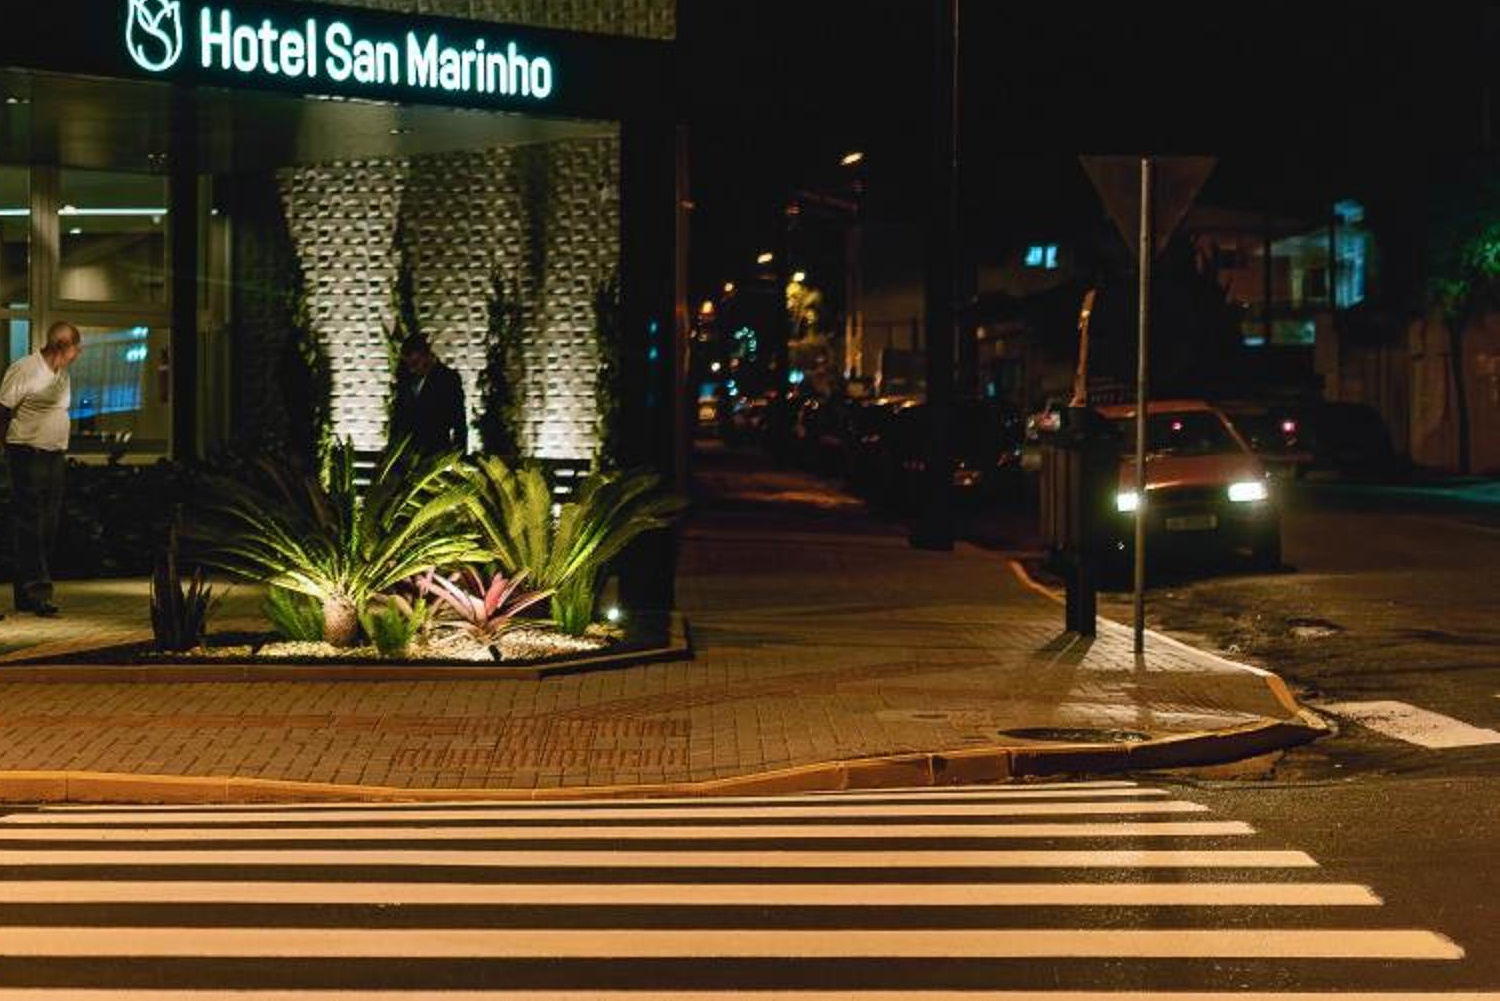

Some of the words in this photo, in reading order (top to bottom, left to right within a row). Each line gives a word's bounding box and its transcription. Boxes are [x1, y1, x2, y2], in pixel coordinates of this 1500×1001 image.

[200, 6, 317, 77] Hotel
[325, 21, 399, 85] San
[406, 30, 553, 99] Marinho
